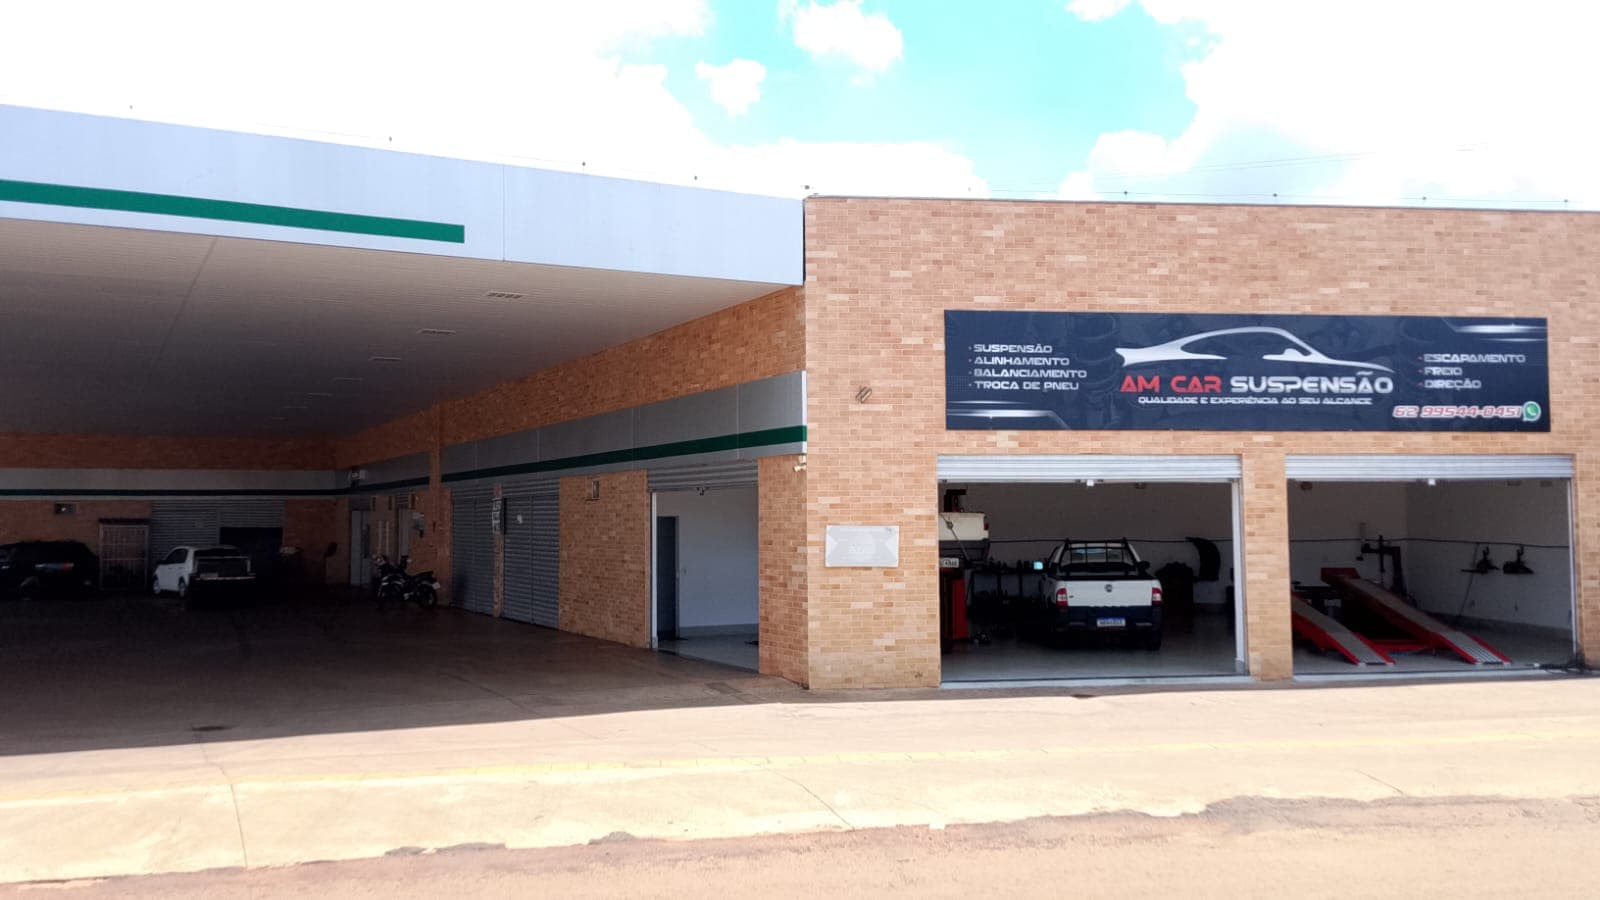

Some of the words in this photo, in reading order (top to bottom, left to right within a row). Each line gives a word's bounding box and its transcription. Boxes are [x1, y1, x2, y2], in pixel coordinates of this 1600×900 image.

[973, 343, 1053, 354] SUSPENSÃO
[974, 356, 1070, 366] ALINHAMENTO
[1423, 353, 1526, 364] ESCAPAMENTO
[973, 368, 1088, 379] BALANCIAMENTO
[1424, 366, 1463, 376] FREIO
[974, 380, 1020, 390] TROCA
[1023, 381, 1040, 391] DE
[1043, 381, 1079, 391] PNEU
[1120, 375, 1160, 393] AM
[1170, 375, 1222, 394] CAR
[1230, 370, 1394, 394] SUSPENSÃO
[1424, 378, 1482, 391] DIREÇÃO
[1138, 396, 1198, 405] QUALIDADE
[1200, 396, 1207, 405] E
[1210, 396, 1279, 405] EXPERIÊNCIA
[1281, 396, 1297, 405] AO
[1299, 396, 1320, 405] SEU
[1322, 396, 1373, 405] ALCANCE
[1393, 405, 1419, 418] 62
